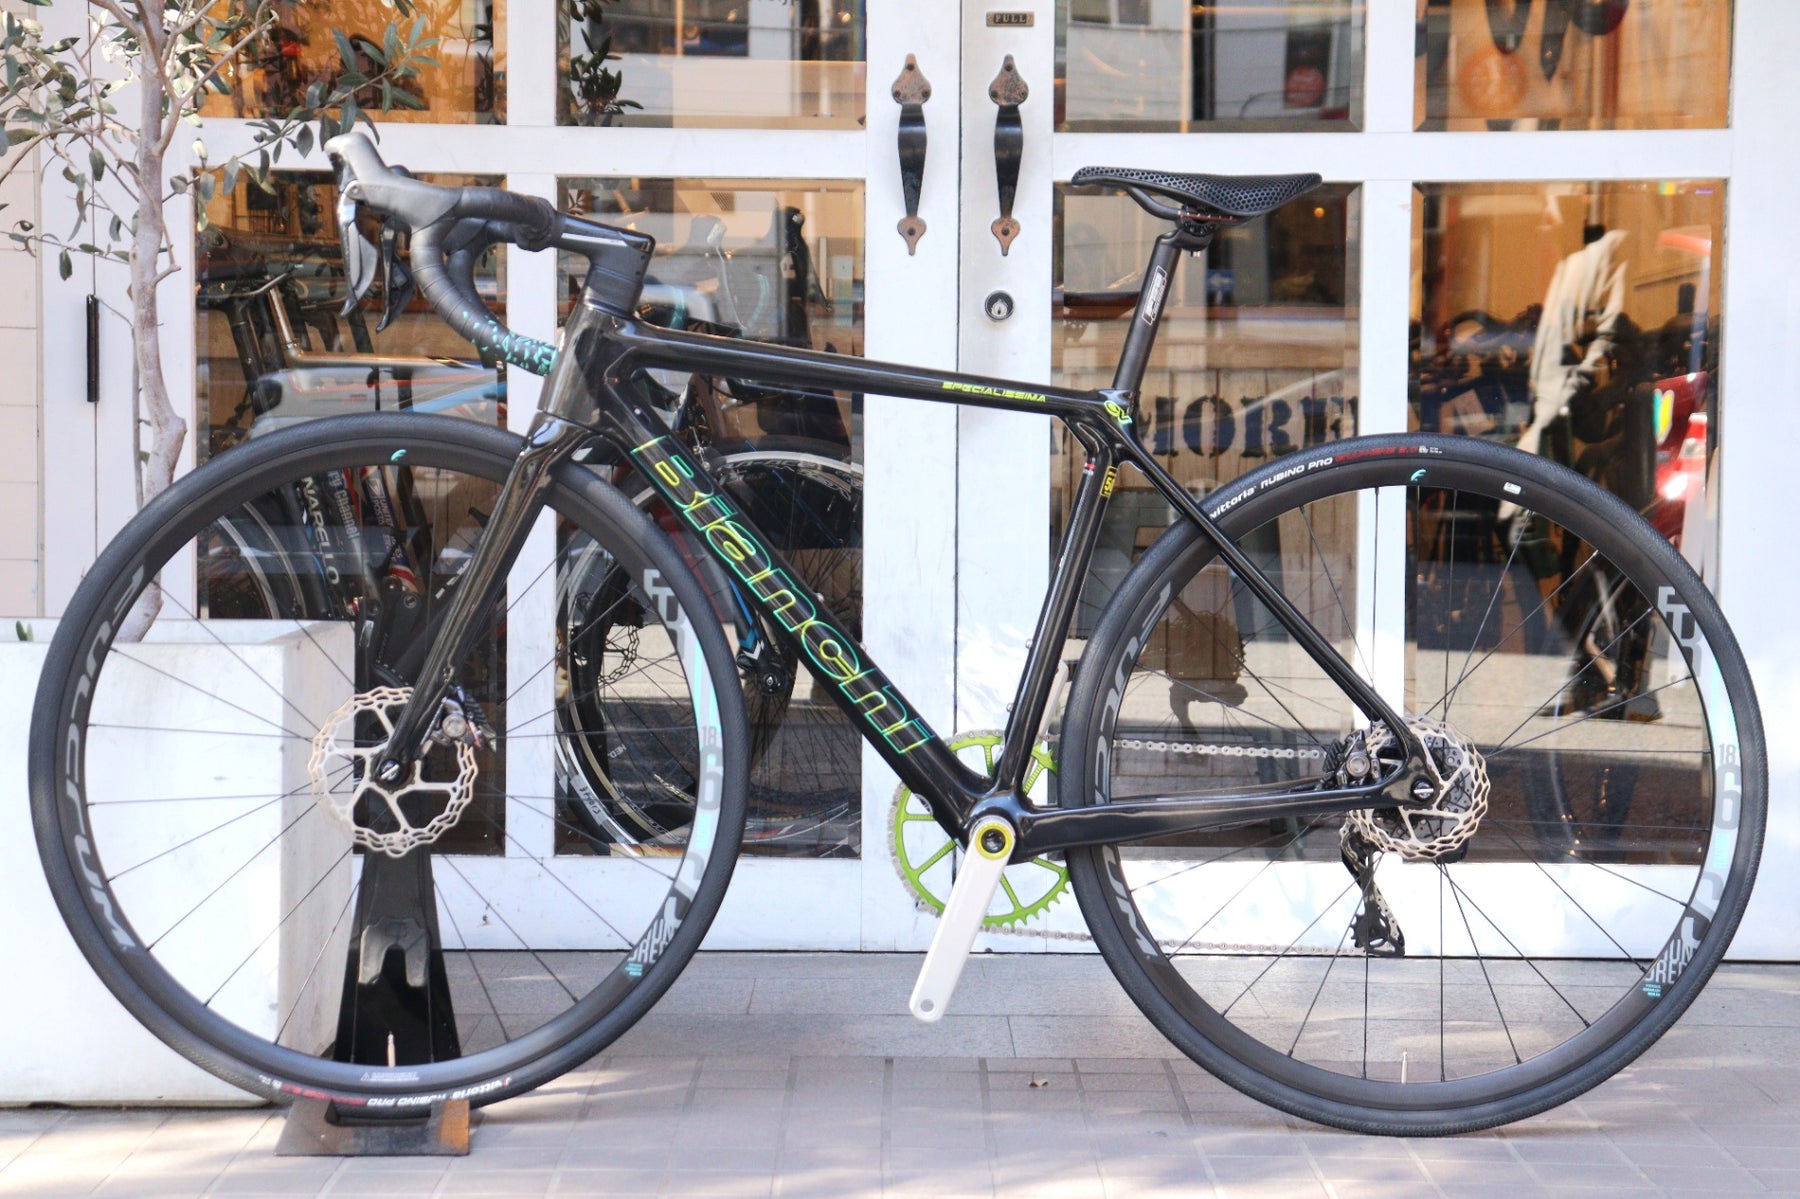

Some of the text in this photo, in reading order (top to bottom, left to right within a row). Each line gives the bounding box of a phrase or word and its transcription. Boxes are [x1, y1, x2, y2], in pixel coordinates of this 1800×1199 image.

[995, 13, 1026, 24] PULL
[942, 381, 1047, 403] SPECIALISSIMA
[1209, 456, 1334, 520] vittoria RUBINO PRO
[334, 489, 361, 540] Channel
[630, 435, 937, 755] Bianchi
[1095, 580, 1172, 958] FULCUM
[366, 1096, 397, 1108] PRO
